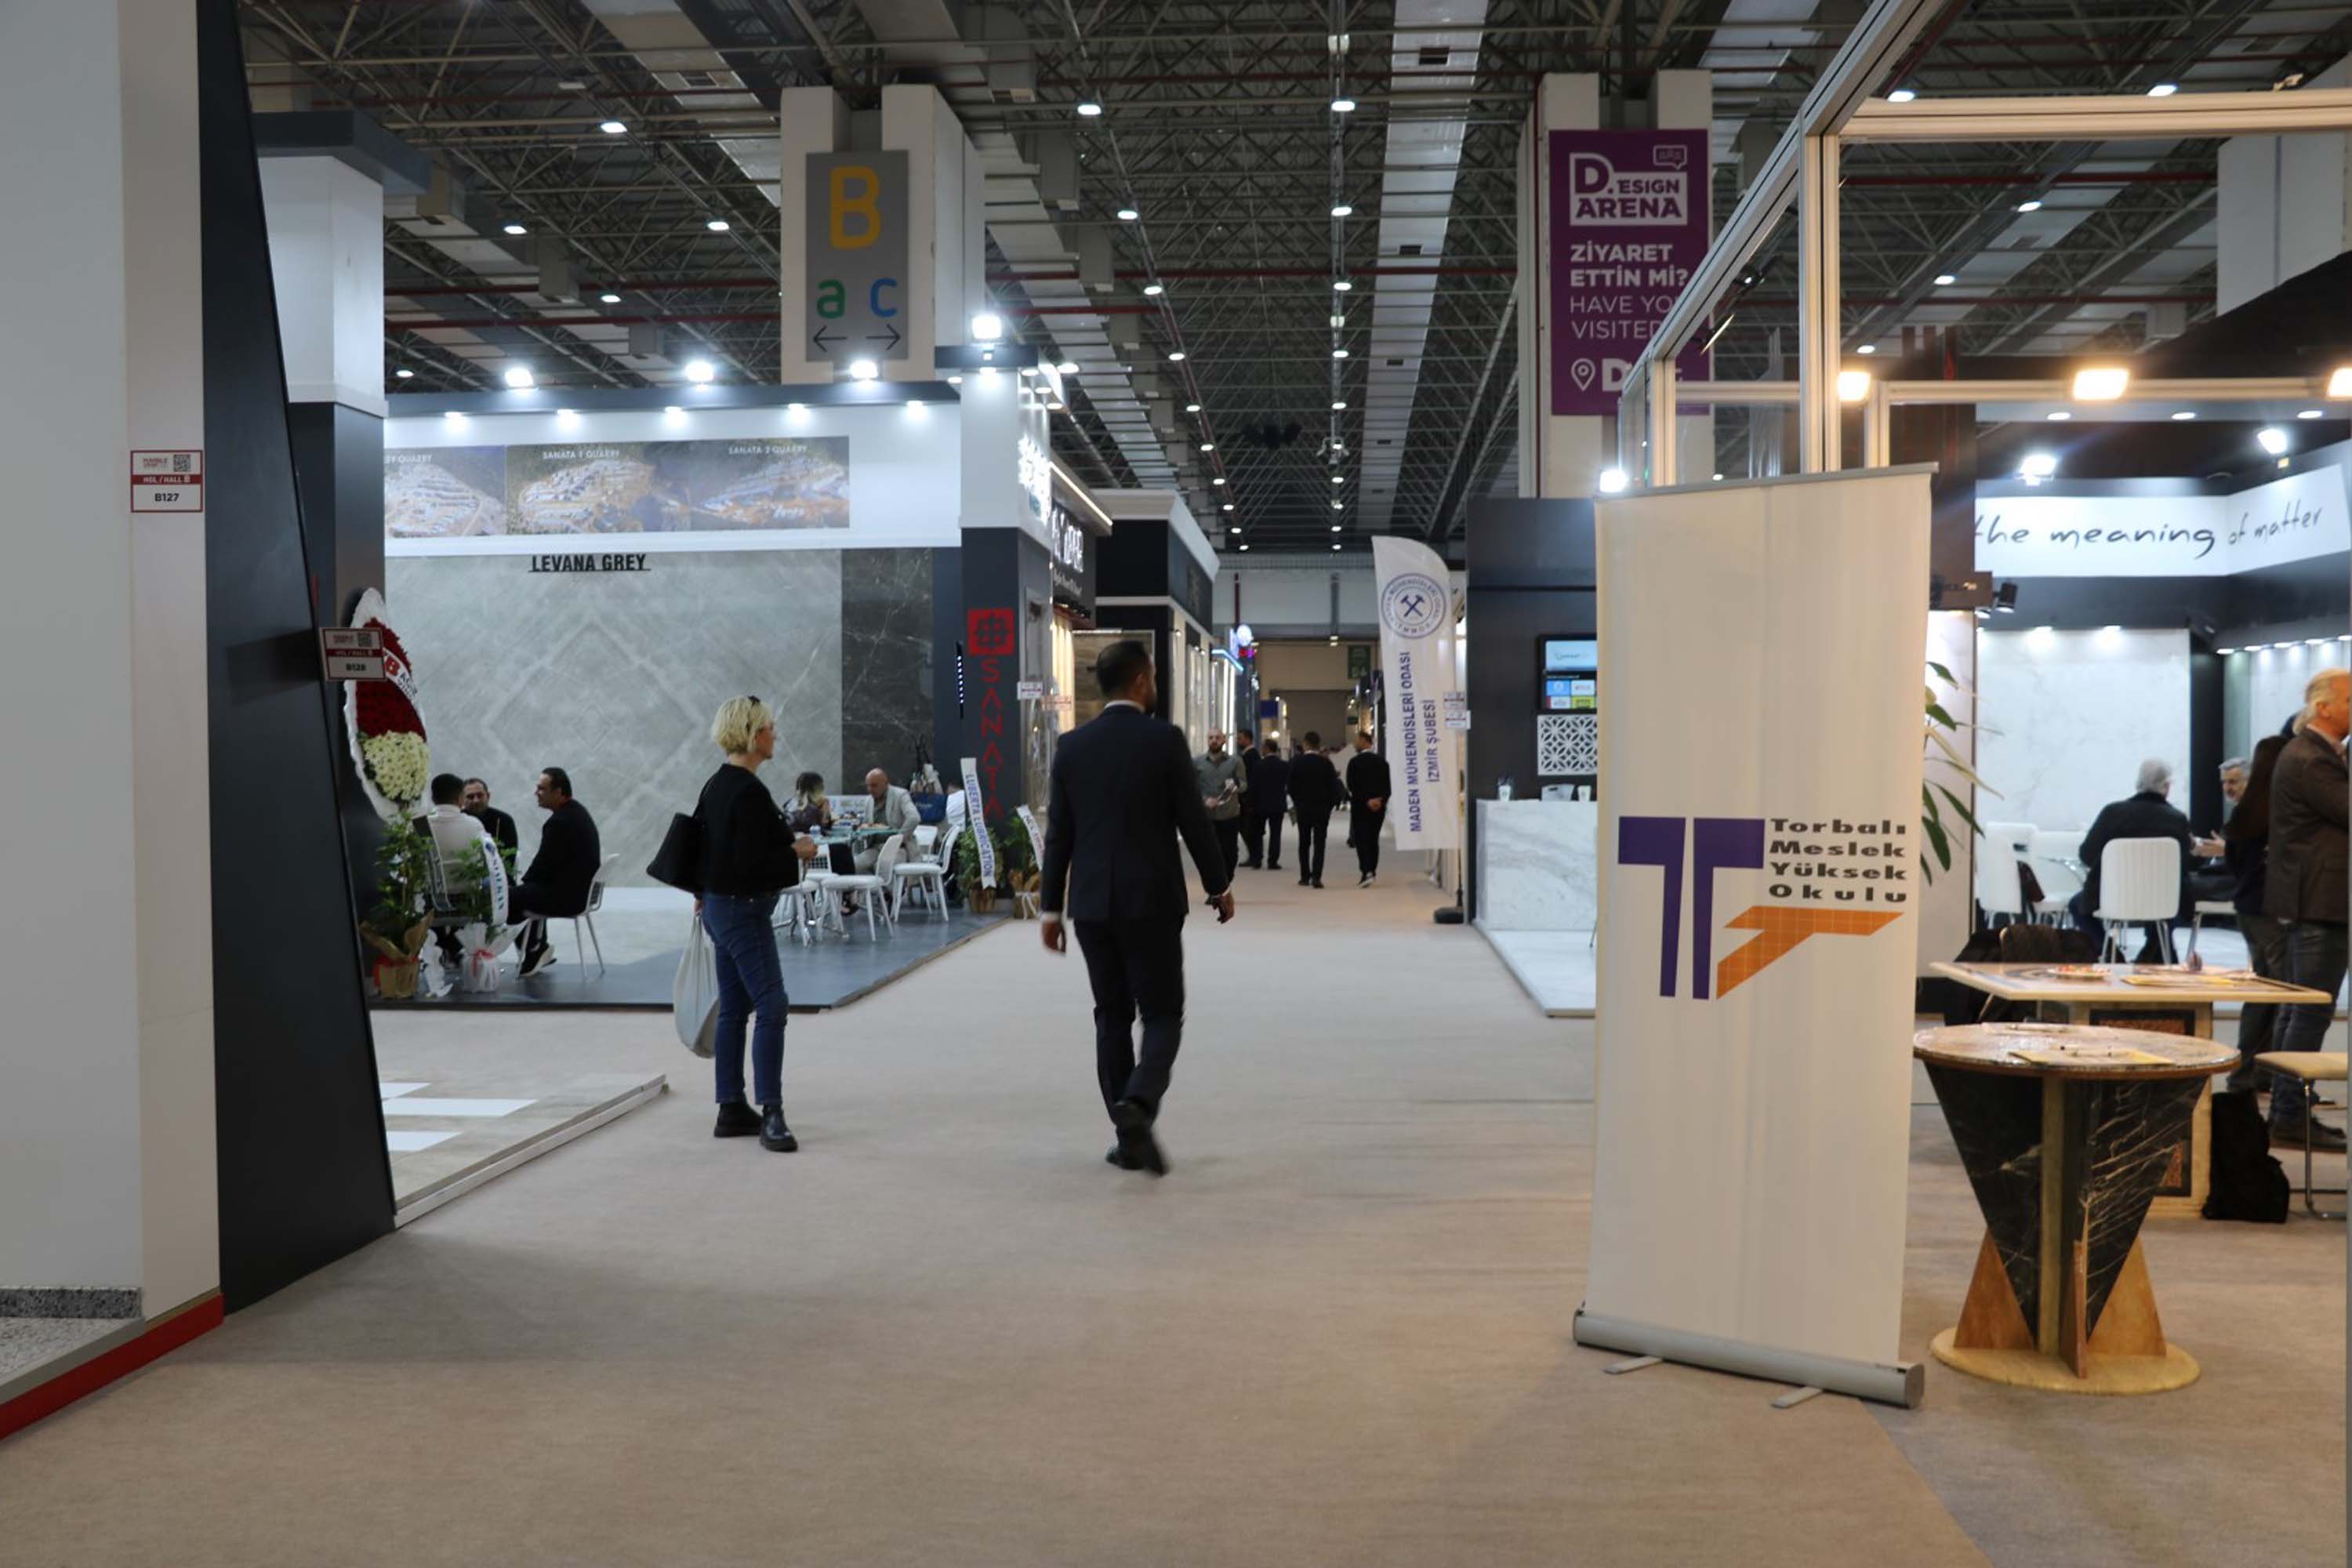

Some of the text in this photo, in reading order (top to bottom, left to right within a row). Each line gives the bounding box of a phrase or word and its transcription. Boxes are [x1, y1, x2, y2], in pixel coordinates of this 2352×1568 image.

[830, 166, 882, 249] B
[1576, 198, 1682, 218] ARENA
[1570, 241, 1673, 262] ZİYARET
[1570, 266, 1689, 287] ETTİN Mİ?
[816, 278, 898, 319] a c
[1570, 295, 1679, 314] HAVE YO
[543, 451, 576, 460] SANATA
[154, 493, 180, 502] B127
[1974, 499, 2323, 559] the meaning of matter
[532, 554, 647, 572] LEVANA GREY
[981, 659, 1004, 820] SANATA
[1399, 652, 1421, 833] MADEN MÜHENDİSLERİ ODASI
[1422, 699, 1440, 782] İZMİR ŞUBESİ
[1770, 818, 1906, 835] Torbalı
[1769, 840, 1905, 858] Meslek
[1770, 862, 1907, 880] Yüksek
[1769, 884, 1907, 903] Okulu
